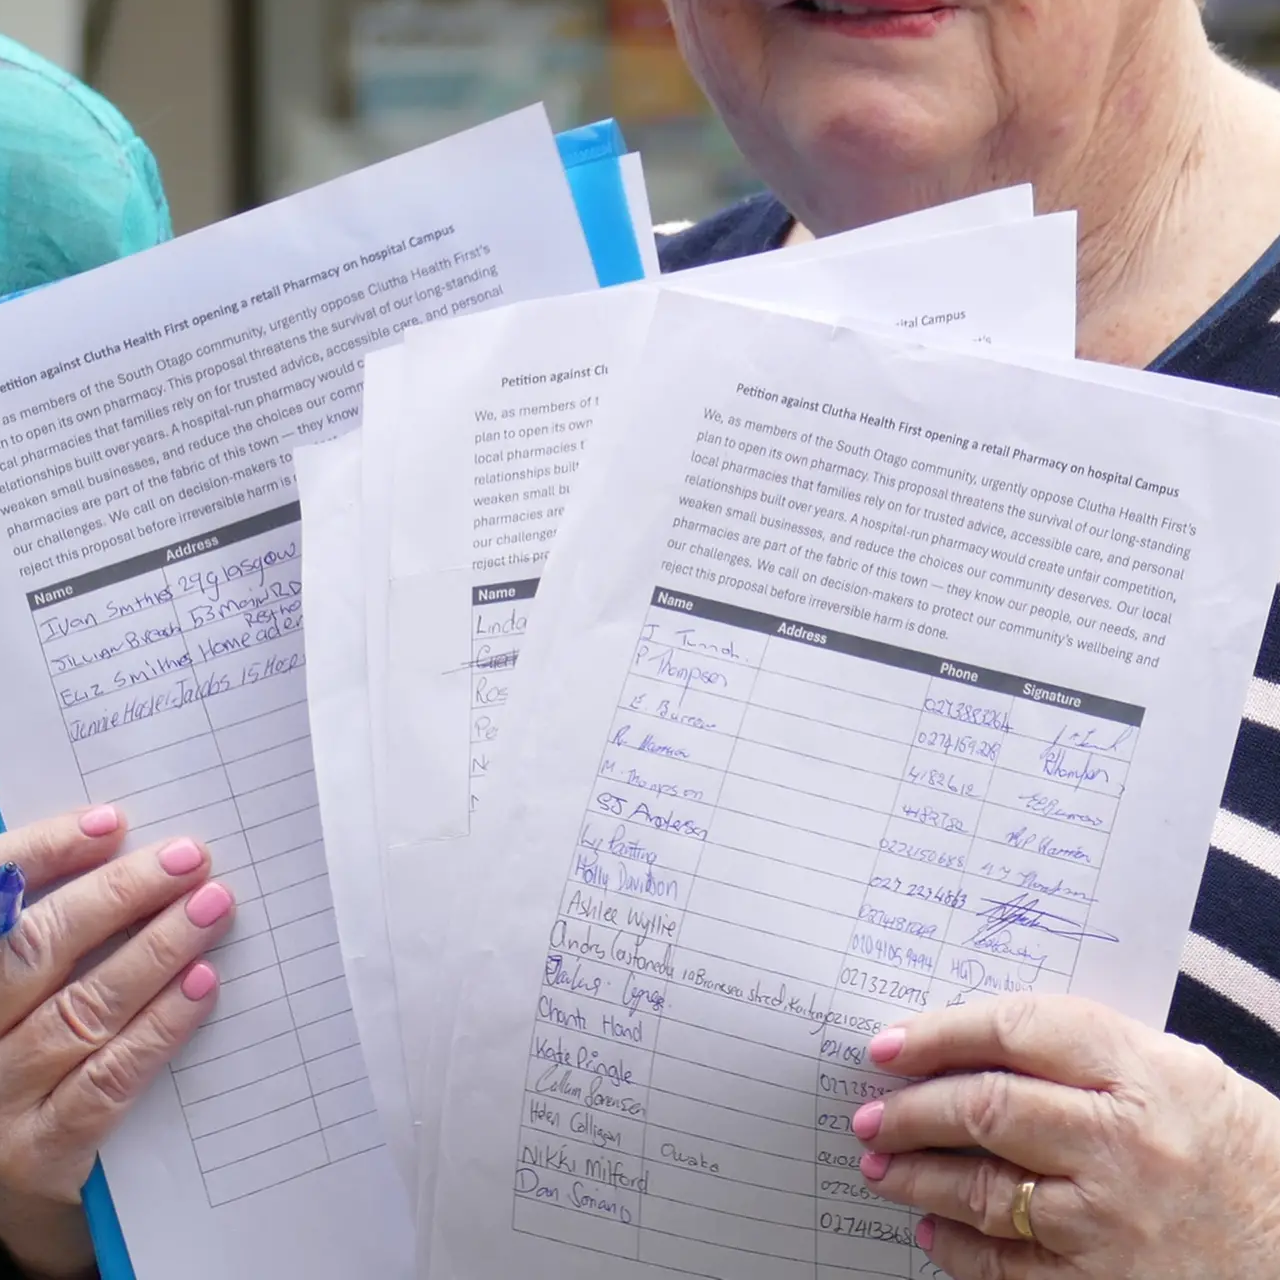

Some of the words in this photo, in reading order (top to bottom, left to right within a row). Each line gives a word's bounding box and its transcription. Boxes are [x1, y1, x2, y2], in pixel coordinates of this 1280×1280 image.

[2, 413, 16, 425] as
[19, 392, 77, 419] members
[79, 384, 92, 398] of
[93, 379, 114, 393] the
[116, 364, 154, 384] South
[155, 351, 193, 371] Otago
[195, 325, 266, 357] community,
[268, 306, 317, 331] urgently
[320, 290, 365, 312] oppose
[367, 274, 408, 295] Clutha
[410, 257, 451, 280] Health
[453, 244, 490, 264] First's
[9, 433, 23, 444] to
[25, 422, 56, 439] open
[57, 415, 73, 428] its
[75, 406, 101, 422] own
[103, 384, 166, 415] pharmacy.
[166, 374, 193, 389] This
[195, 352, 248, 383] proposal
[248, 333, 307, 360] threatens
[308, 325, 329, 340] the
[330, 306, 377, 332] survival
[378, 300, 391, 315] of
[393, 294, 412, 309] our
[414, 264, 498, 301] long-standing
[39, 357, 81, 379] against
[83, 344, 121, 363] Clutha
[122, 328, 162, 349] Health
[163, 319, 189, 335] First
[191, 302, 239, 325] opening
[240, 299, 248, 308] a
[250, 284, 280, 304] retail
[282, 266, 339, 293] Pharmacy
[342, 260, 358, 271] on
[359, 239, 406, 265] hospital
[408, 224, 454, 247] Campus
[920, 310, 966, 326] Campus
[474, 410, 496, 422] We,
[501, 408, 515, 418] as
[519, 401, 575, 415] members
[579, 396, 591, 408] of
[474, 431, 500, 445] plan
[503, 429, 515, 439] to
[518, 425, 548, 438] open
[551, 423, 565, 432] its
[501, 374, 546, 387] Petition
[550, 368, 591, 384] against
[474, 451, 504, 464] local
[506, 441, 576, 462] pharmacies
[696, 430, 722, 445] plan
[723, 436, 736, 448] to
[737, 441, 766, 456] open
[768, 448, 782, 460] its
[784, 452, 808, 466] own
[809, 457, 868, 482] pharmacy.
[873, 470, 895, 487] This
[896, 480, 948, 500] proposal
[950, 491, 1004, 513] threatens
[1006, 504, 1025, 518] the
[1027, 511, 1073, 529] survival
[1074, 521, 1088, 533] of
[1088, 525, 1109, 538] our
[1110, 527, 1190, 561] long-standing
[703, 407, 723, 424] We,
[727, 415, 741, 427] as
[744, 420, 797, 440] members
[800, 432, 812, 444] of
[814, 435, 833, 448] the
[835, 439, 870, 458] South
[873, 448, 907, 467] Otago
[910, 460, 976, 485] community,
[980, 476, 1027, 497] urgently
[1030, 488, 1073, 506] oppose
[1077, 496, 1115, 516] Clutha
[1118, 506, 1158, 526] Health
[1160, 516, 1196, 536] First's
[736, 382, 778, 402] Petition
[780, 395, 819, 412] against
[821, 403, 857, 420] Clutha
[859, 412, 895, 429] Health
[898, 421, 922, 436] First
[924, 429, 969, 450] opening
[971, 440, 978, 449] a
[980, 443, 1010, 457] retail
[1011, 448, 1068, 473] Pharmacy
[1070, 464, 1084, 475] on
[1086, 464, 1133, 486] hospital
[1134, 477, 1179, 497] Campus
[34, 585, 74, 605] Name
[165, 536, 219, 561] Address
[690, 449, 719, 467] local
[720, 460, 787, 484] pharmacies
[790, 475, 813, 491] that
[816, 480, 861, 502] families
[863, 495, 885, 510] rely
[887, 500, 902, 512] on
[904, 502, 921, 515] for
[923, 508, 965, 527] trusted
[966, 519, 1006, 539] advice,
[1010, 530, 1072, 553] accessible
[1075, 546, 1103, 562] care,
[1106, 553, 1130, 567] and
[1131, 559, 1184, 580] personal
[478, 587, 516, 601] Name
[657, 592, 694, 611] Name
[777, 622, 827, 645] Address
[940, 662, 978, 682] Phone
[1023, 682, 1081, 708] Signature
